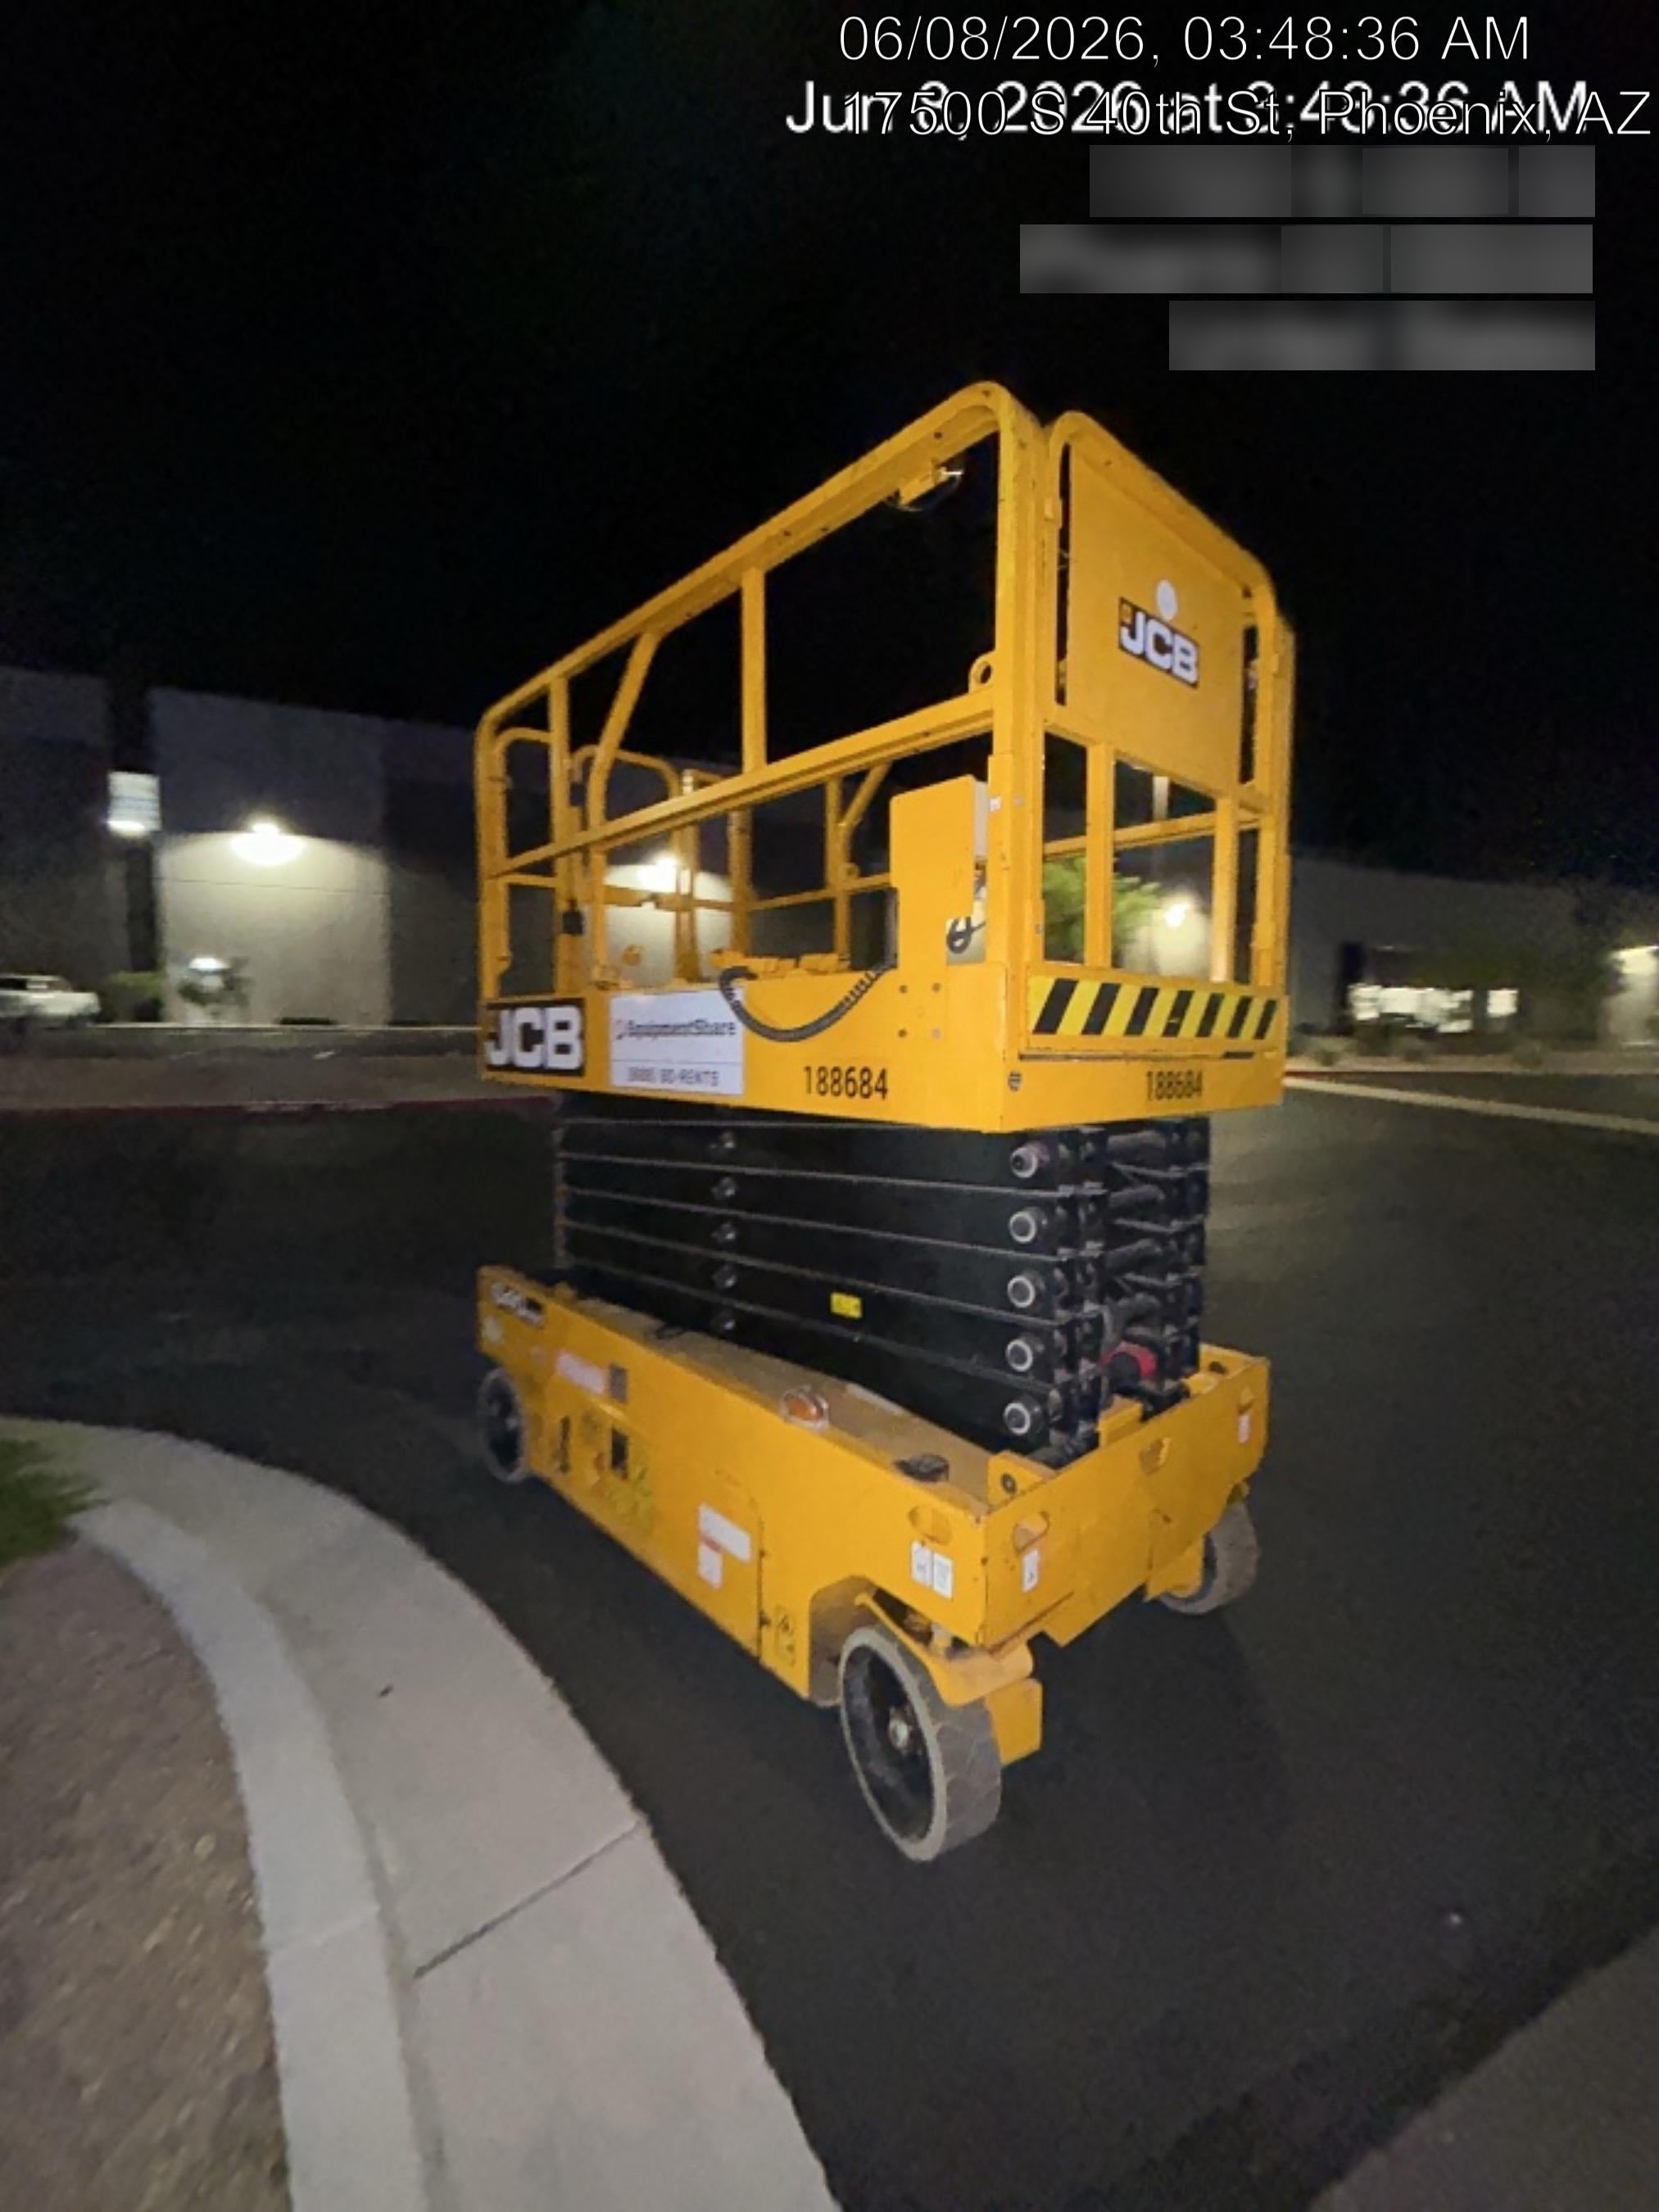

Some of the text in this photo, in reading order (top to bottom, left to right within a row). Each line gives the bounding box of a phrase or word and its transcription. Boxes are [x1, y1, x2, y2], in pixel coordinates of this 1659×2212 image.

[1119, 610, 1199, 685] JCB
[484, 1005, 583, 1070] JCB
[804, 1065, 888, 1100] 188684
[1146, 1069, 1203, 1101] 188684
